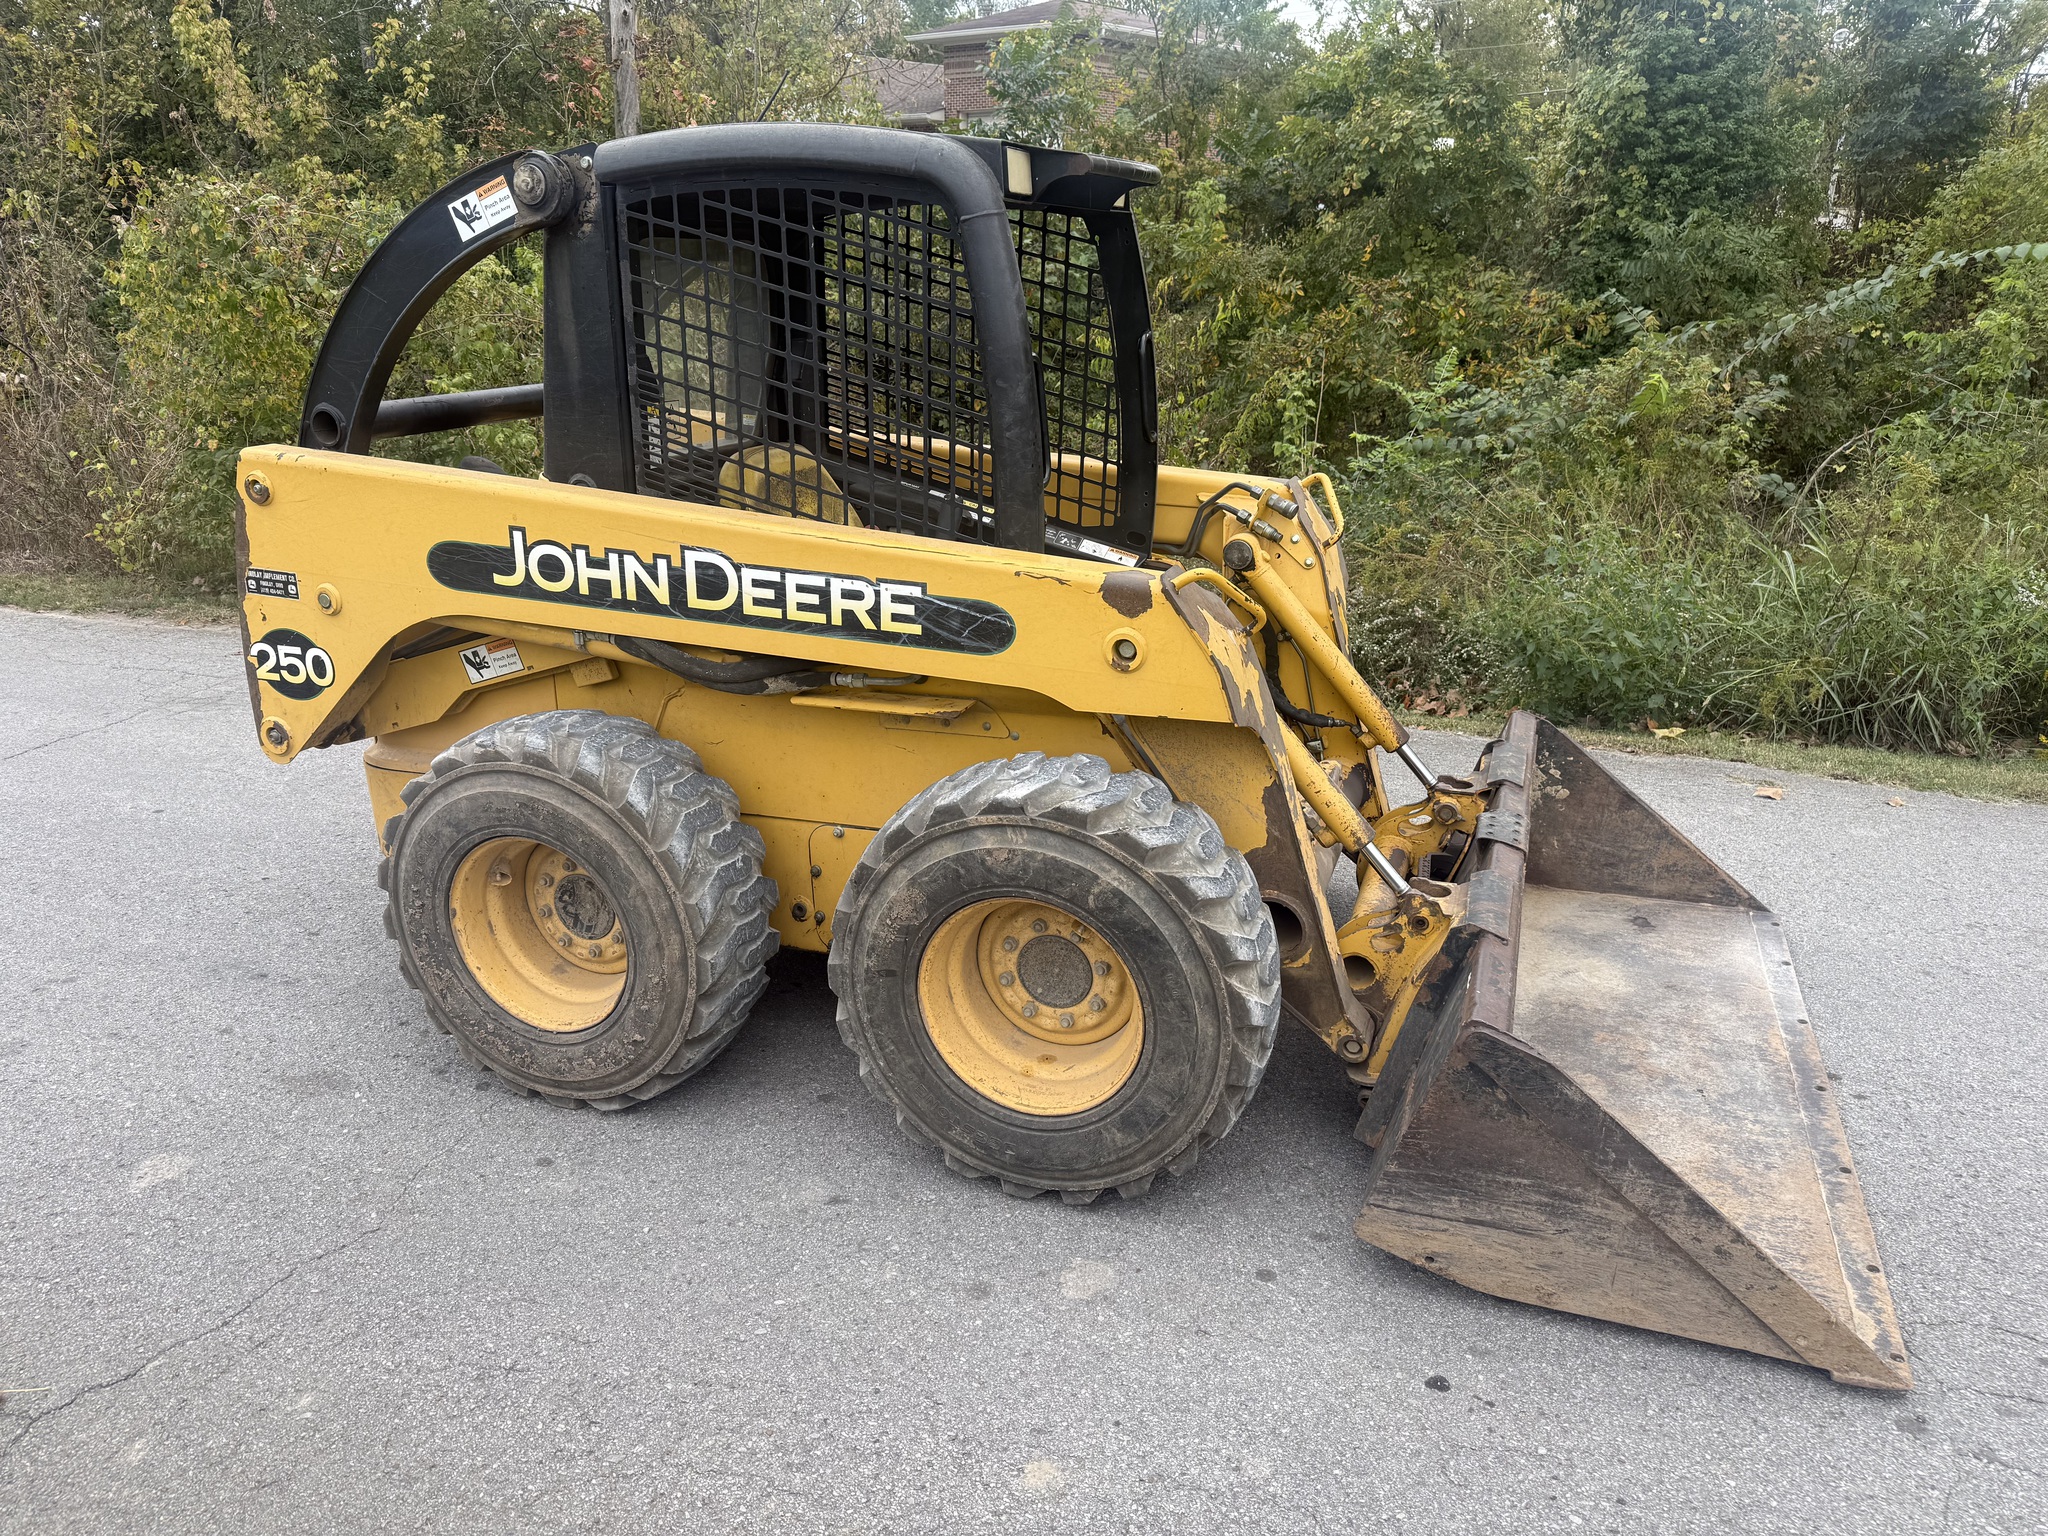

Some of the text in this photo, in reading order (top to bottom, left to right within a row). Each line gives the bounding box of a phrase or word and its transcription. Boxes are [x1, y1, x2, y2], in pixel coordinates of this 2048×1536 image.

[483, 178, 505, 195] WARNING
[484, 194, 511, 211] Pinch Area
[492, 530, 922, 636] JOHN DEERE
[250, 642, 335, 687] 250
[493, 652, 517, 663] Pinch Area
